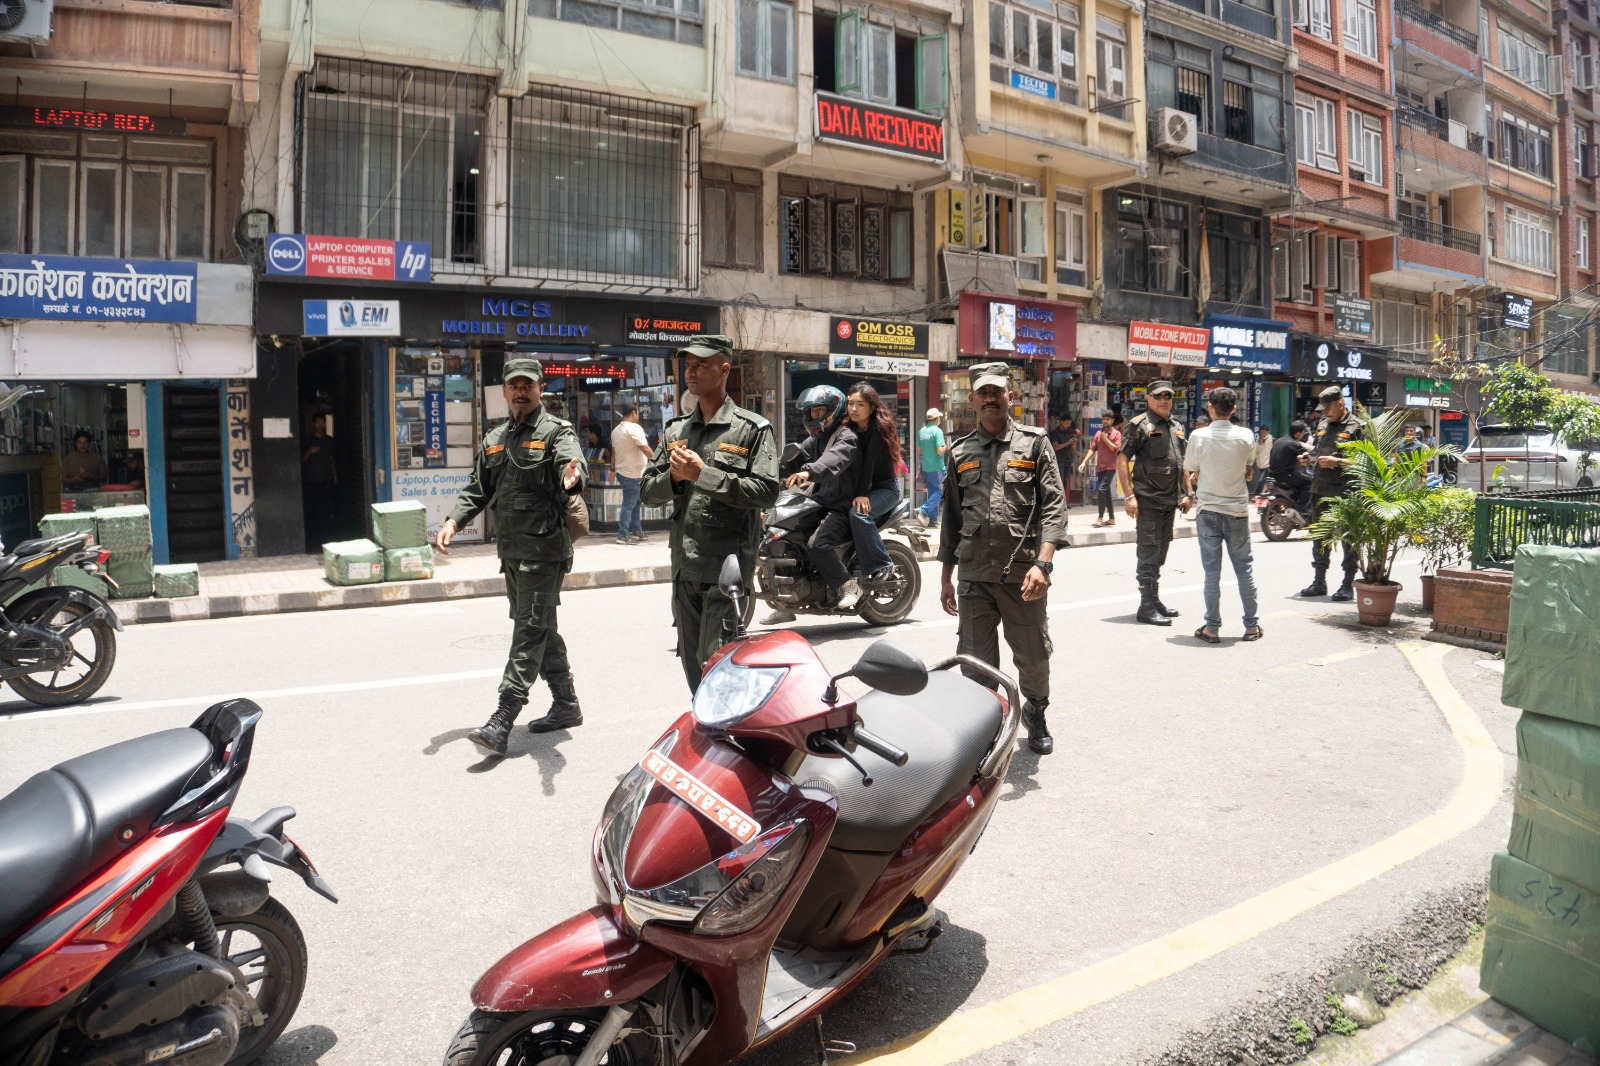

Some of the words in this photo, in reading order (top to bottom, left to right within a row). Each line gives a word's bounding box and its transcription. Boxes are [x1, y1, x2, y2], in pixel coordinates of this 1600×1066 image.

[1019, 74, 1048, 90] TECNO
[35, 108, 108, 128] LAPTOP
[818, 100, 862, 138] DATA
[864, 110, 942, 153] RECOVERY
[273, 249, 300, 259] DELL
[308, 242, 342, 252] LAPTOP
[345, 244, 393, 254] COMPUTER
[312, 254, 354, 264] PRINTER
[358, 256, 390, 266] SALES
[400, 244, 426, 278] hp
[328, 265, 334, 274] &
[336, 266, 373, 276] SERVICE
[92, 264, 194, 305] कलेक्शन
[43, 303, 70, 314] सम्पर्क
[361, 307, 388, 322] EMI
[482, 298, 552, 317] MCS
[442, 320, 506, 334] MOBILE
[516, 322, 588, 336] GALLERY
[858, 322, 882, 334] OM
[886, 324, 914, 336] OSR
[1134, 326, 1160, 340] MOBILE
[1160, 330, 1178, 342] ZONE
[858, 334, 914, 345] ELECTRONICS
[1213, 326, 1254, 348] MOBILE
[1256, 330, 1288, 349] POINT
[1130, 348, 1146, 357] Sales
[1150, 349, 1169, 358] Repair
[1173, 352, 1204, 362] Accessories
[1337, 367, 1372, 380] X-STORE
[431, 394, 440, 424] TECH
[1254, 382, 1262, 422] MOBILE
[1430, 397, 1450, 408] ASUS
[431, 427, 440, 450] PRO
[401, 487, 428, 497] Sales
[430, 486, 438, 496] &
[440, 486, 463, 495] serv
[131, 876, 154, 902] 160
[582, 966, 605, 976] Combi
[605, 964, 626, 972] Brake
